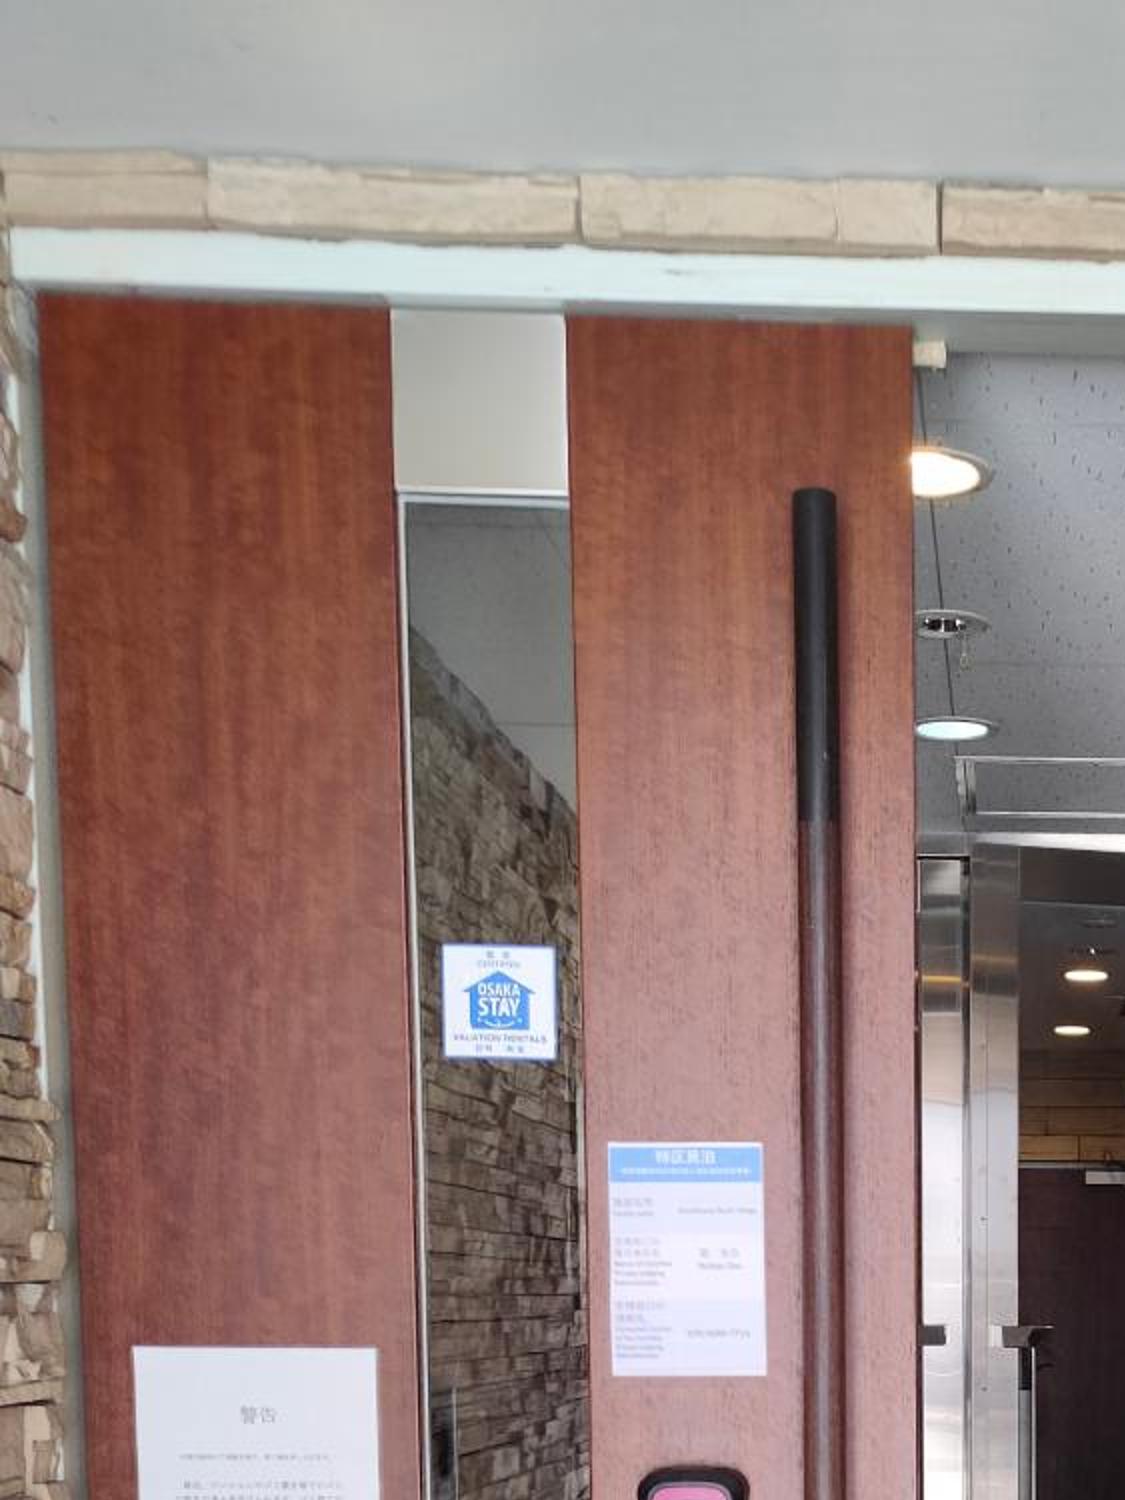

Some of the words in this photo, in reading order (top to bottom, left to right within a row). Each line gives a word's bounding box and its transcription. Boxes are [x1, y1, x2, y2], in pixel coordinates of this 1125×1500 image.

[477, 982, 521, 998] OSAKA
[478, 997, 521, 1017] STAY
[239, 1404, 278, 1426] 警告
